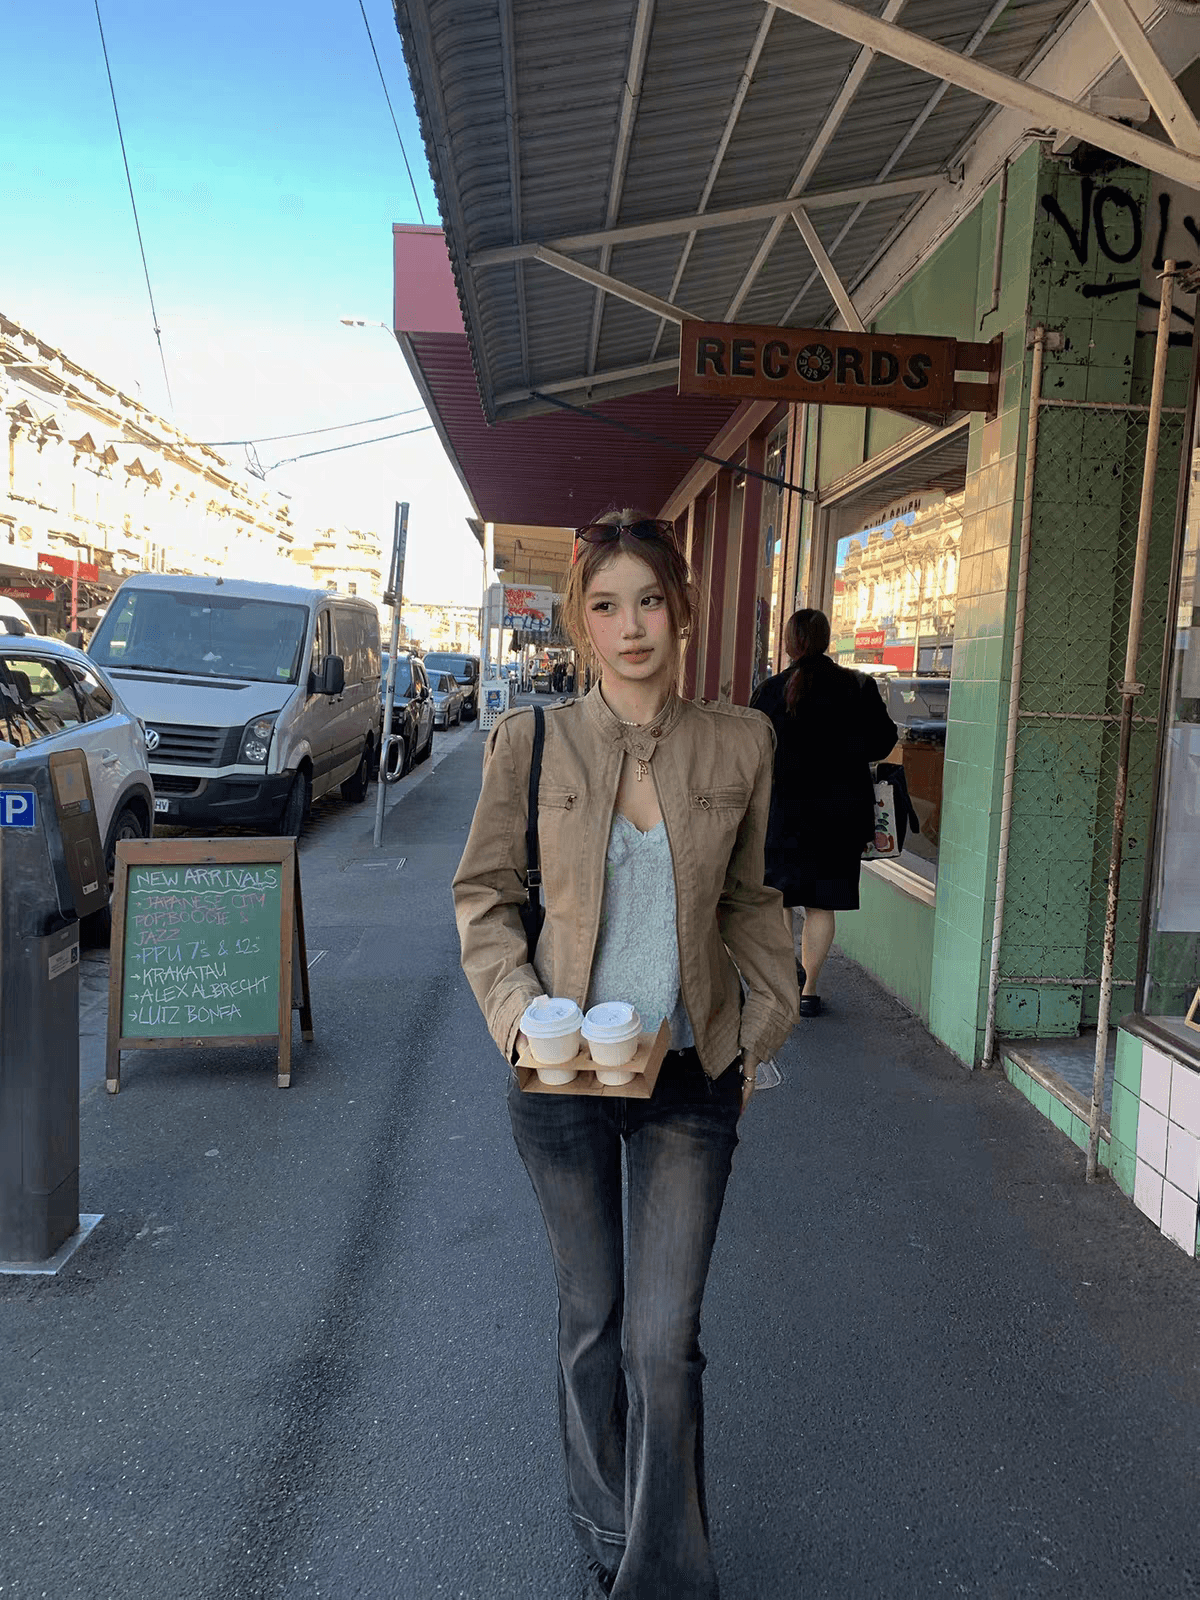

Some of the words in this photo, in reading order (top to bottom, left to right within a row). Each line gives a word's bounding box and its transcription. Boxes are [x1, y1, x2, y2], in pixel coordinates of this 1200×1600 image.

[695, 337, 933, 391] RECORDS
[798, 349, 818, 379] SEVEN
[816, 345, 831, 371] PLUG
[5, 794, 28, 824] P
[136, 871, 178, 887] NEW
[184, 868, 277, 888] ARRIVALS
[141, 894, 227, 911] JAPANESE
[232, 893, 266, 908] CITY
[239, 911, 249, 924] &
[135, 929, 182, 946] JAZZ
[142, 946, 183, 964] PPU
[217, 940, 229, 955] &
[142, 962, 227, 986] KRAKATAU
[140, 988, 190, 1004] ALEX
[191, 976, 270, 1001] ALBRECHT
